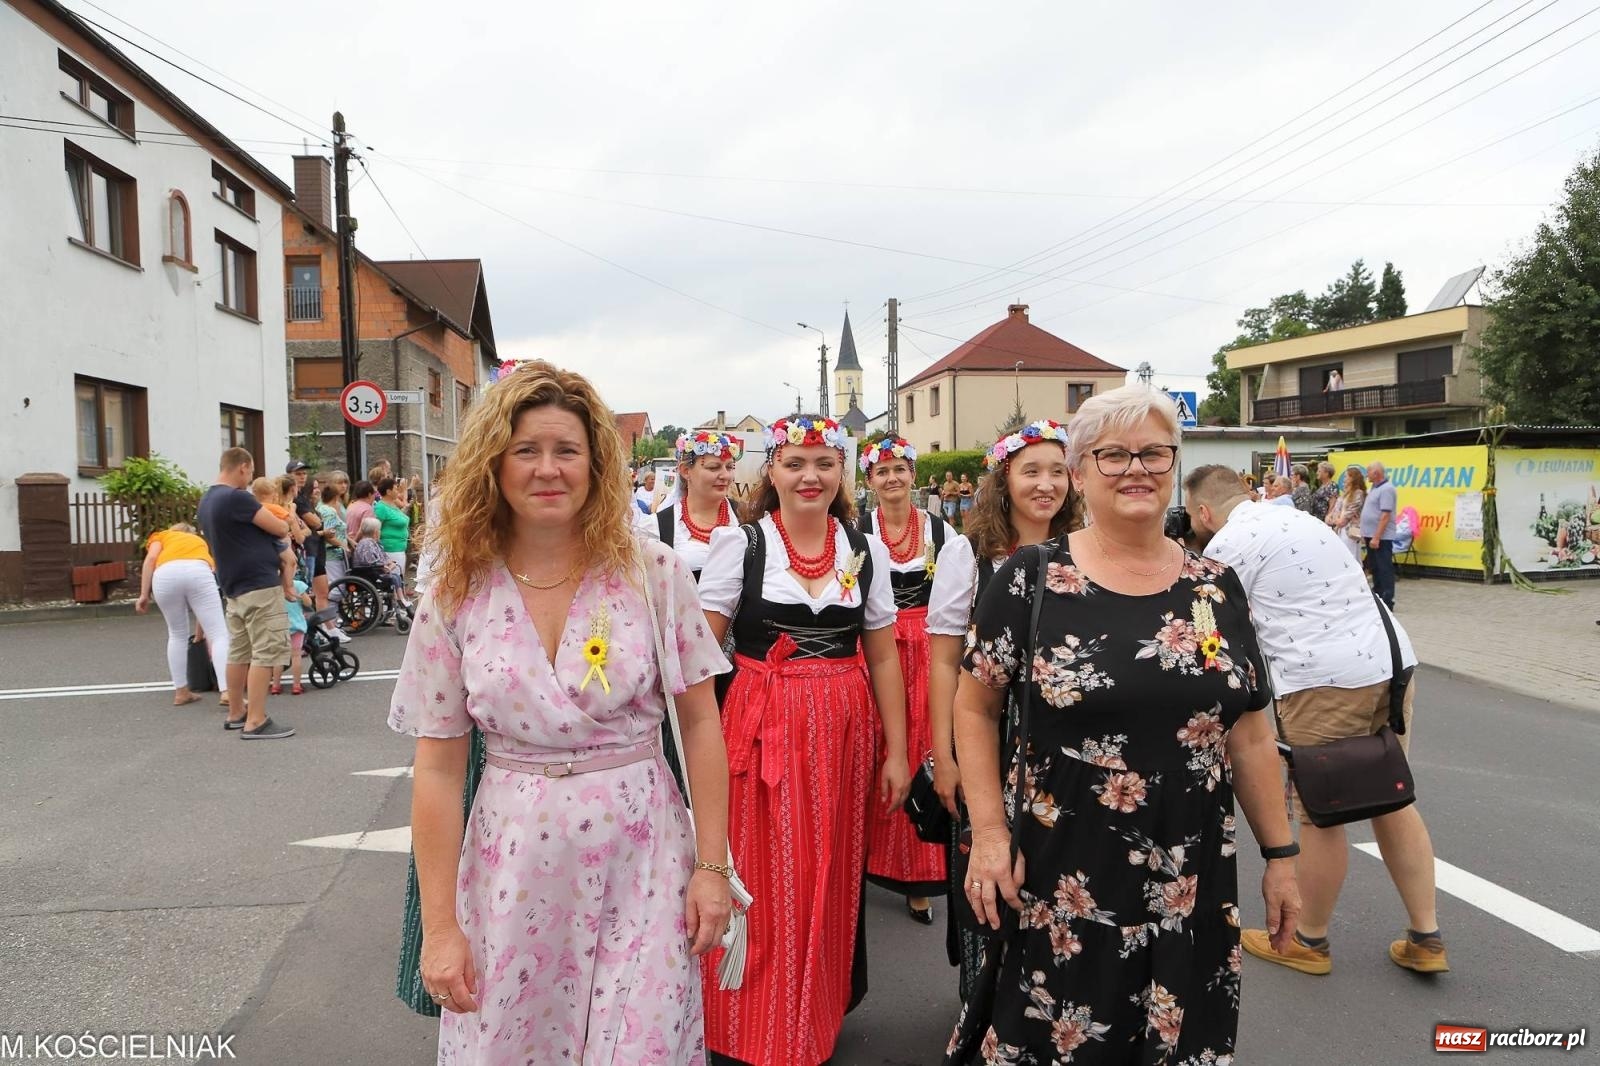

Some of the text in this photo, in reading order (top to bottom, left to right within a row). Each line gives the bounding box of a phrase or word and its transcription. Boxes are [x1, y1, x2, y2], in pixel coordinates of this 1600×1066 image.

[390, 394, 408, 402] Lompy
[1537, 459, 1594, 473] LEWIATAN
[1384, 464, 1475, 488] EWIATAN
